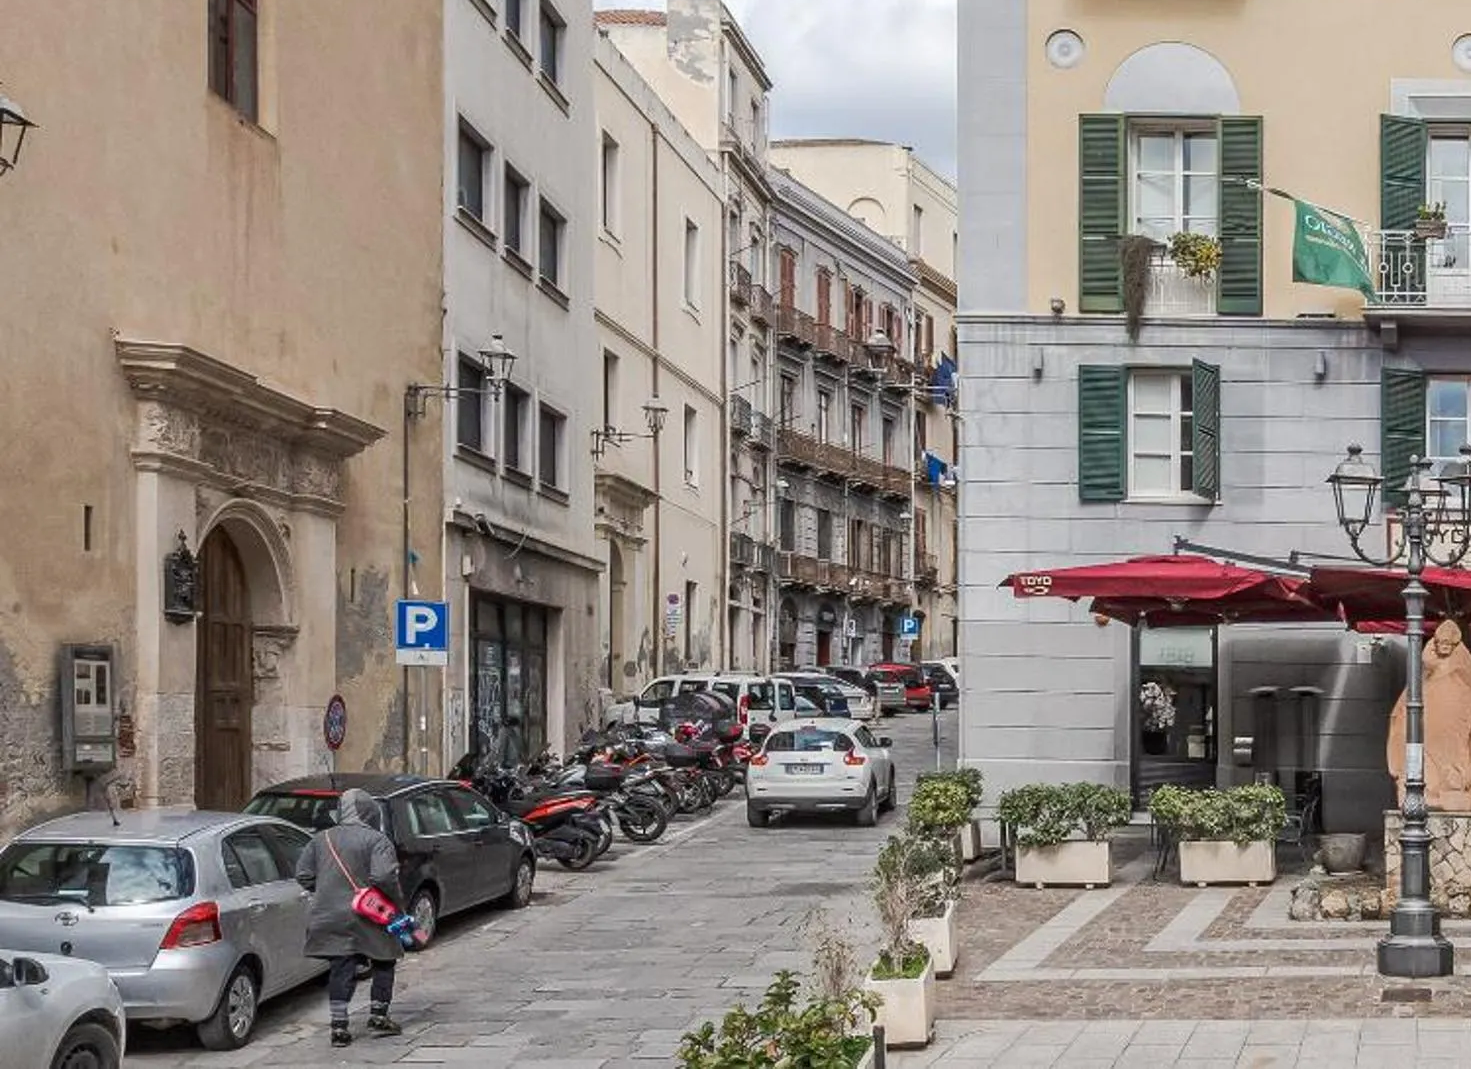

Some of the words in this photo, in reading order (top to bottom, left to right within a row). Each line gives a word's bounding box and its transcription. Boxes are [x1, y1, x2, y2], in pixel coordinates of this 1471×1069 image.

[1020, 575, 1052, 586] TOYO
[405, 605, 438, 644] P
[903, 619, 915, 633] P
